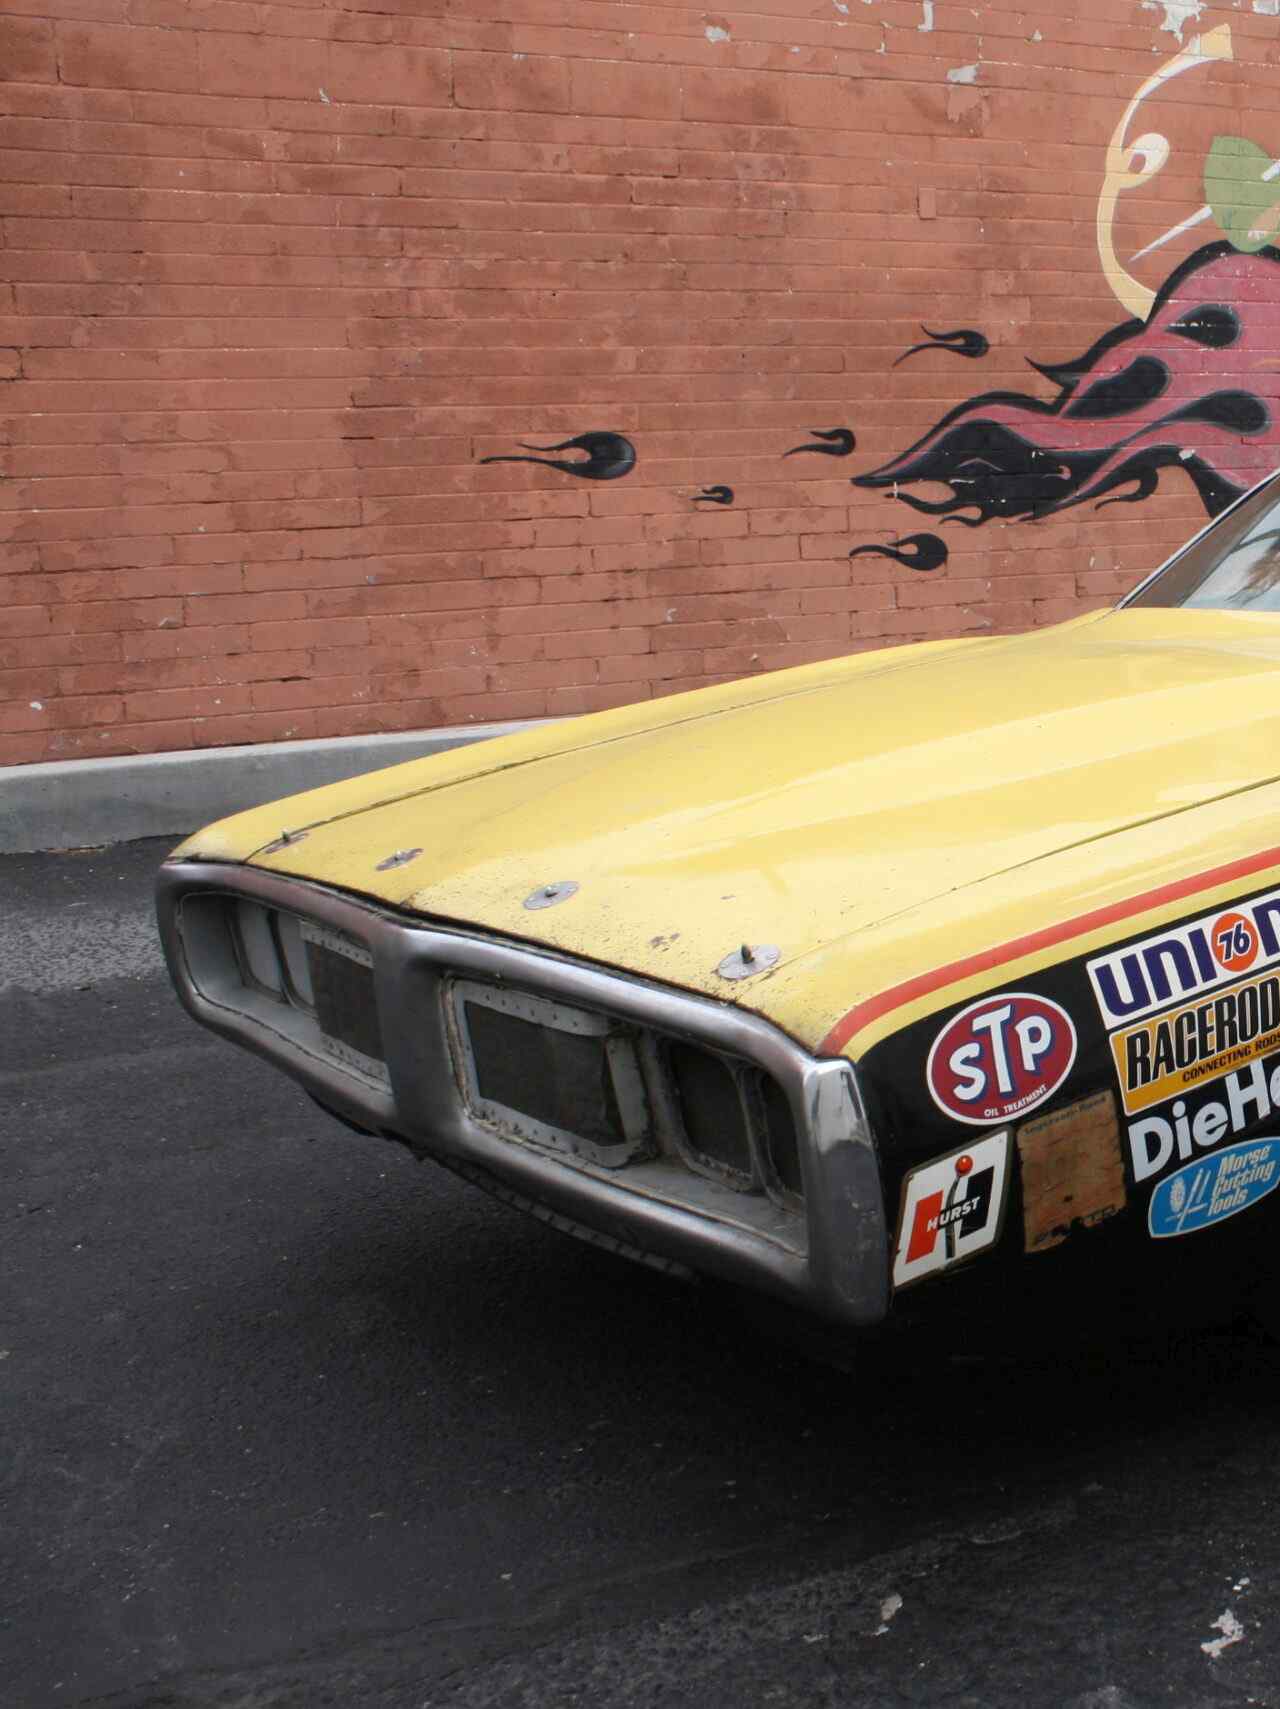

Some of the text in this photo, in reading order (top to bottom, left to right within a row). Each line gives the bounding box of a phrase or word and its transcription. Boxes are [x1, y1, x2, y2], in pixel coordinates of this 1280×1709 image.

[1217, 923, 1250, 961] 76
[949, 1004, 1053, 1101] STP
[1182, 1045, 1251, 1083] CONNECTING
[983, 1107, 999, 1118] OIL
[1003, 1084, 1048, 1115] TREATMENT
[1215, 1160, 1276, 1196] Cutting
[1219, 1143, 1273, 1177] Morse
[926, 1196, 981, 1232] HURST
[1208, 1187, 1249, 1217] Tools
